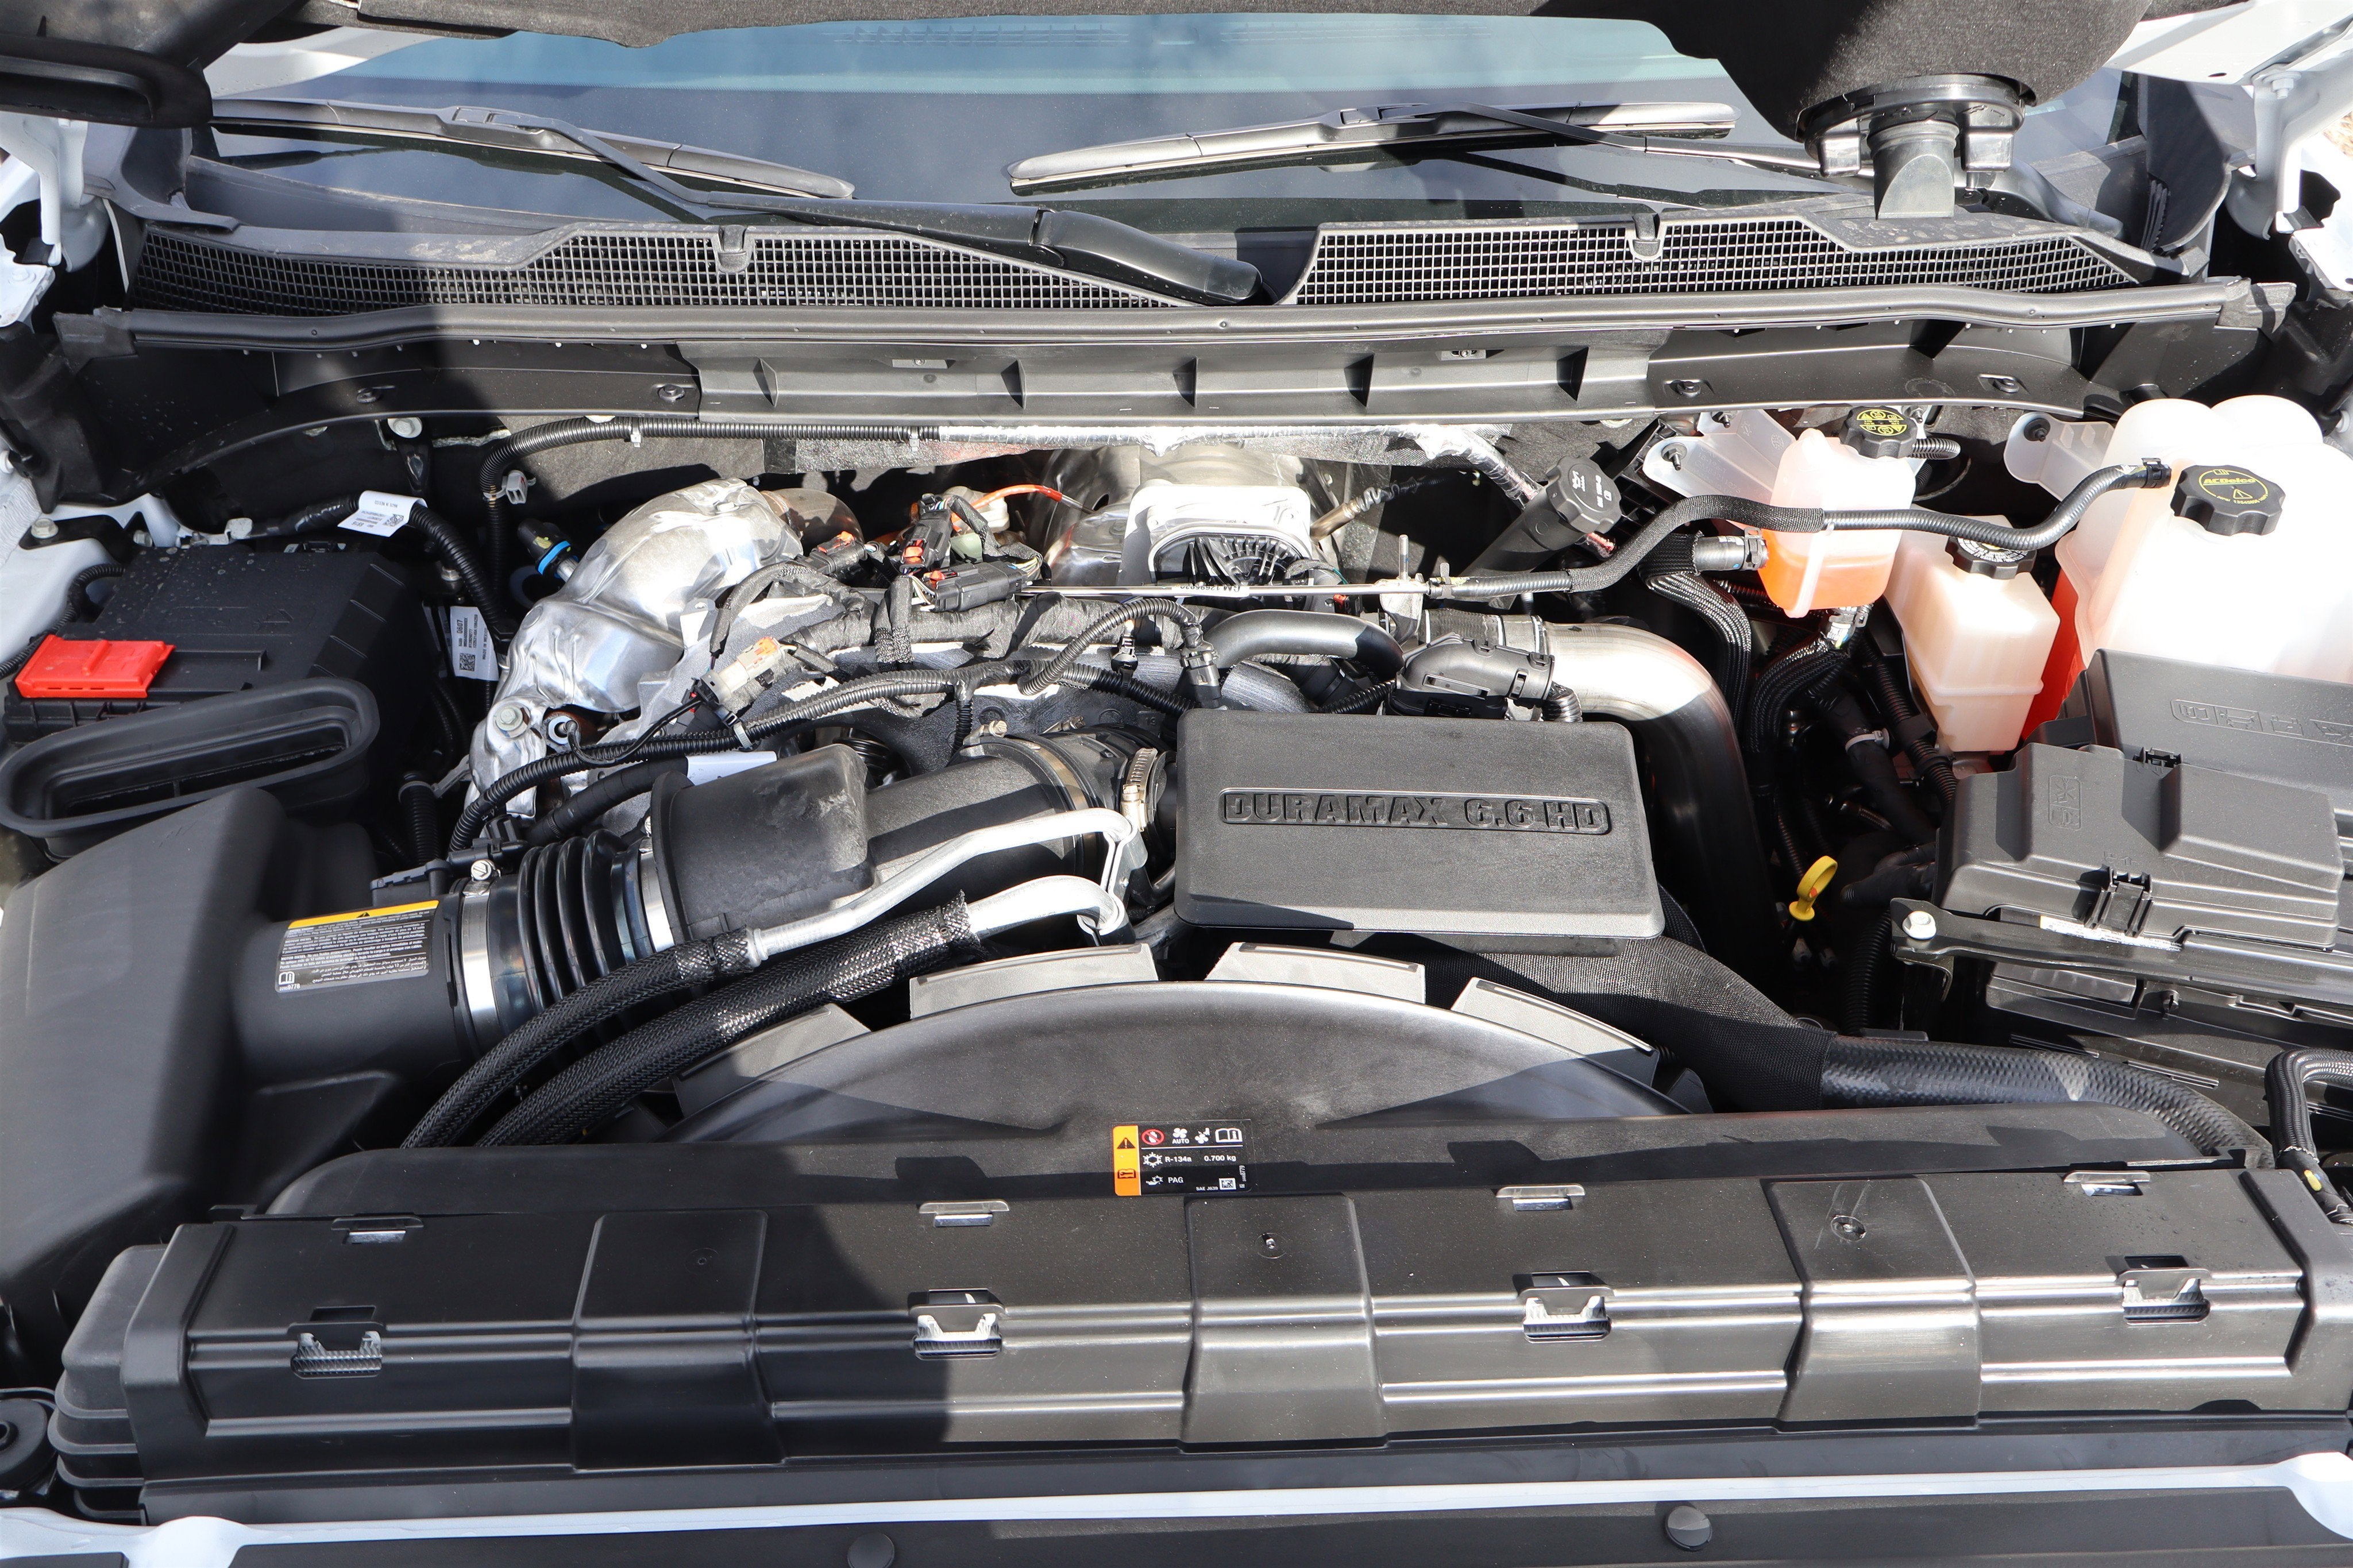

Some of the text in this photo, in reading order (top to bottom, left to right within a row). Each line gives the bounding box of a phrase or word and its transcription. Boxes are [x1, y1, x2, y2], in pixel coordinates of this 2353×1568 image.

[1224, 792, 1607, 834] DURAMAX 6.6 HD
